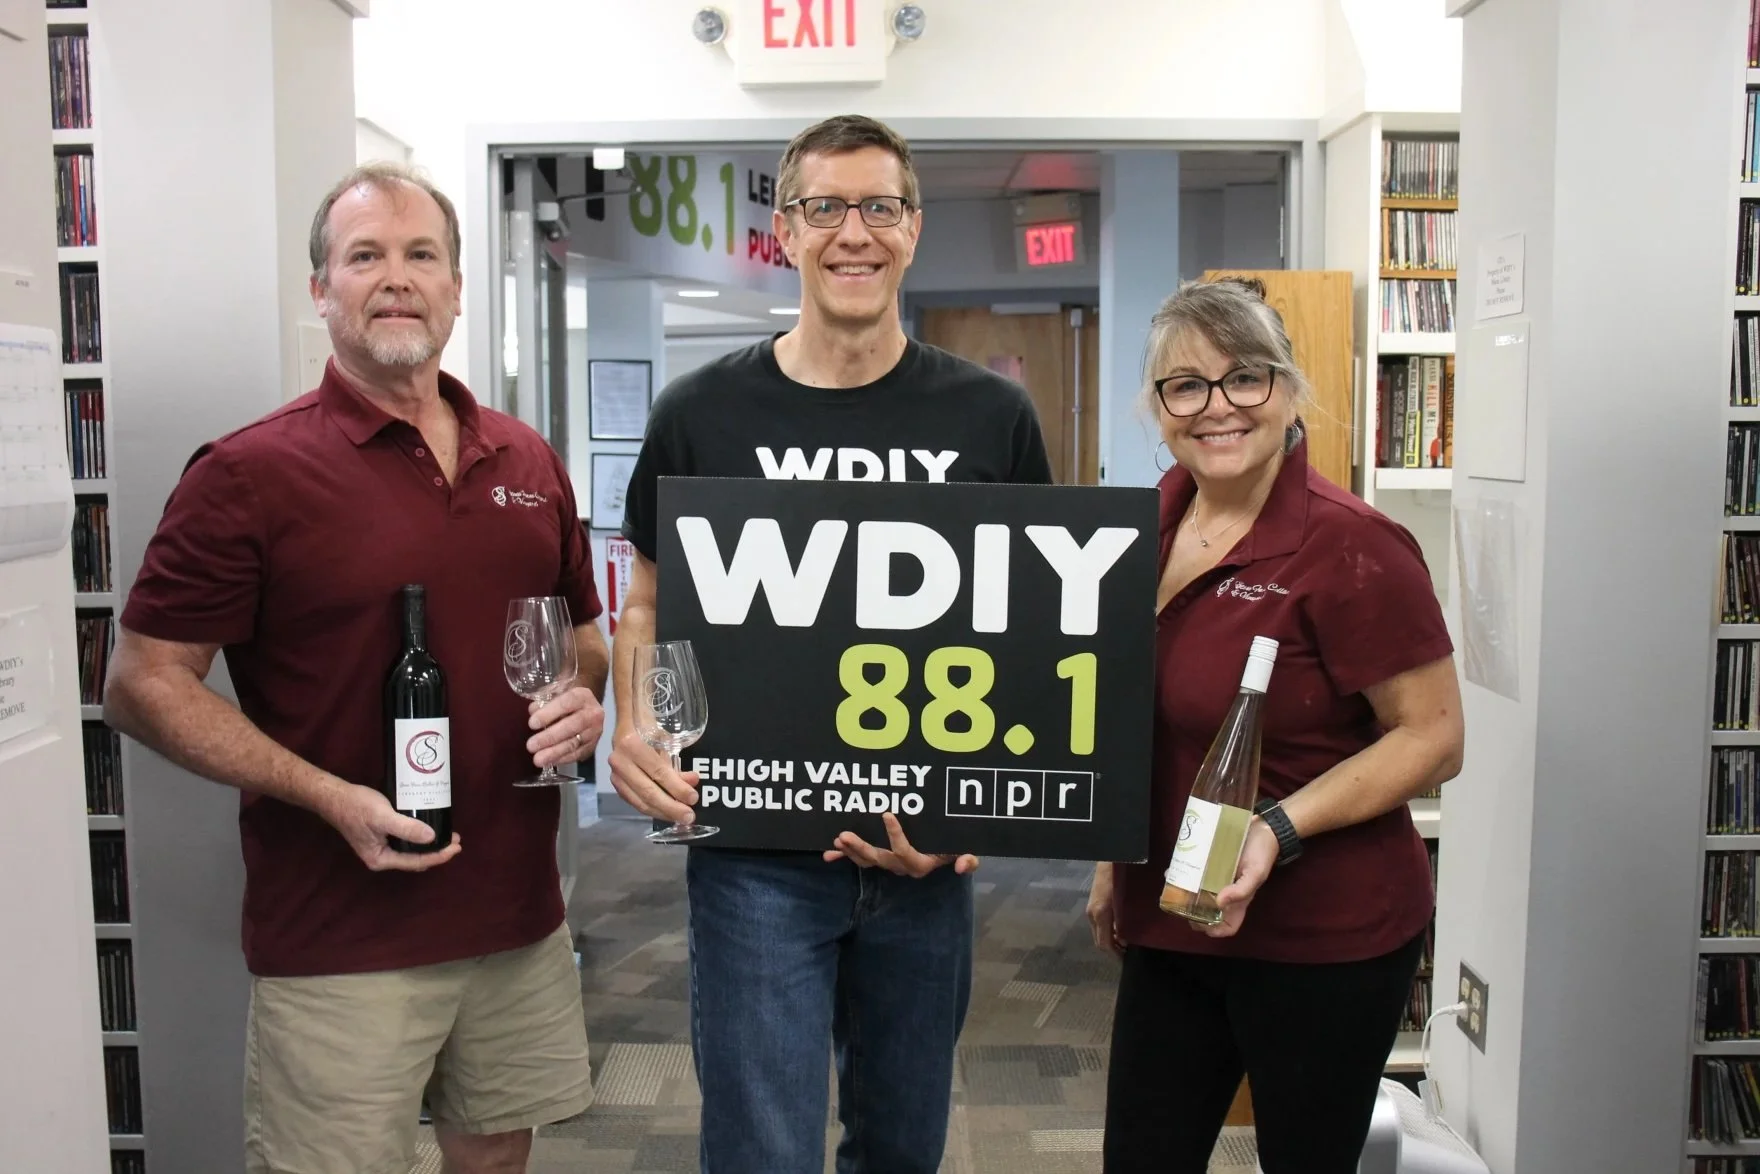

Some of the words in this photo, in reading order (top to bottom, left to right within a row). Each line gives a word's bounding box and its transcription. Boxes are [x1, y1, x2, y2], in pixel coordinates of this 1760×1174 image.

[764, 0, 855, 48] EXIT
[629, 155, 735, 256] 88.1
[1026, 225, 1075, 266] EXIT
[755, 447, 959, 483] WDIY
[676, 516, 1139, 635] WDIY
[835, 643, 1097, 756] 88.1
[680, 757, 794, 783] EHIGH
[804, 761, 932, 788] VALLEY
[701, 785, 813, 811] PUBLIC
[823, 790, 925, 816] RADIO
[959, 778, 1077, 816] npr
